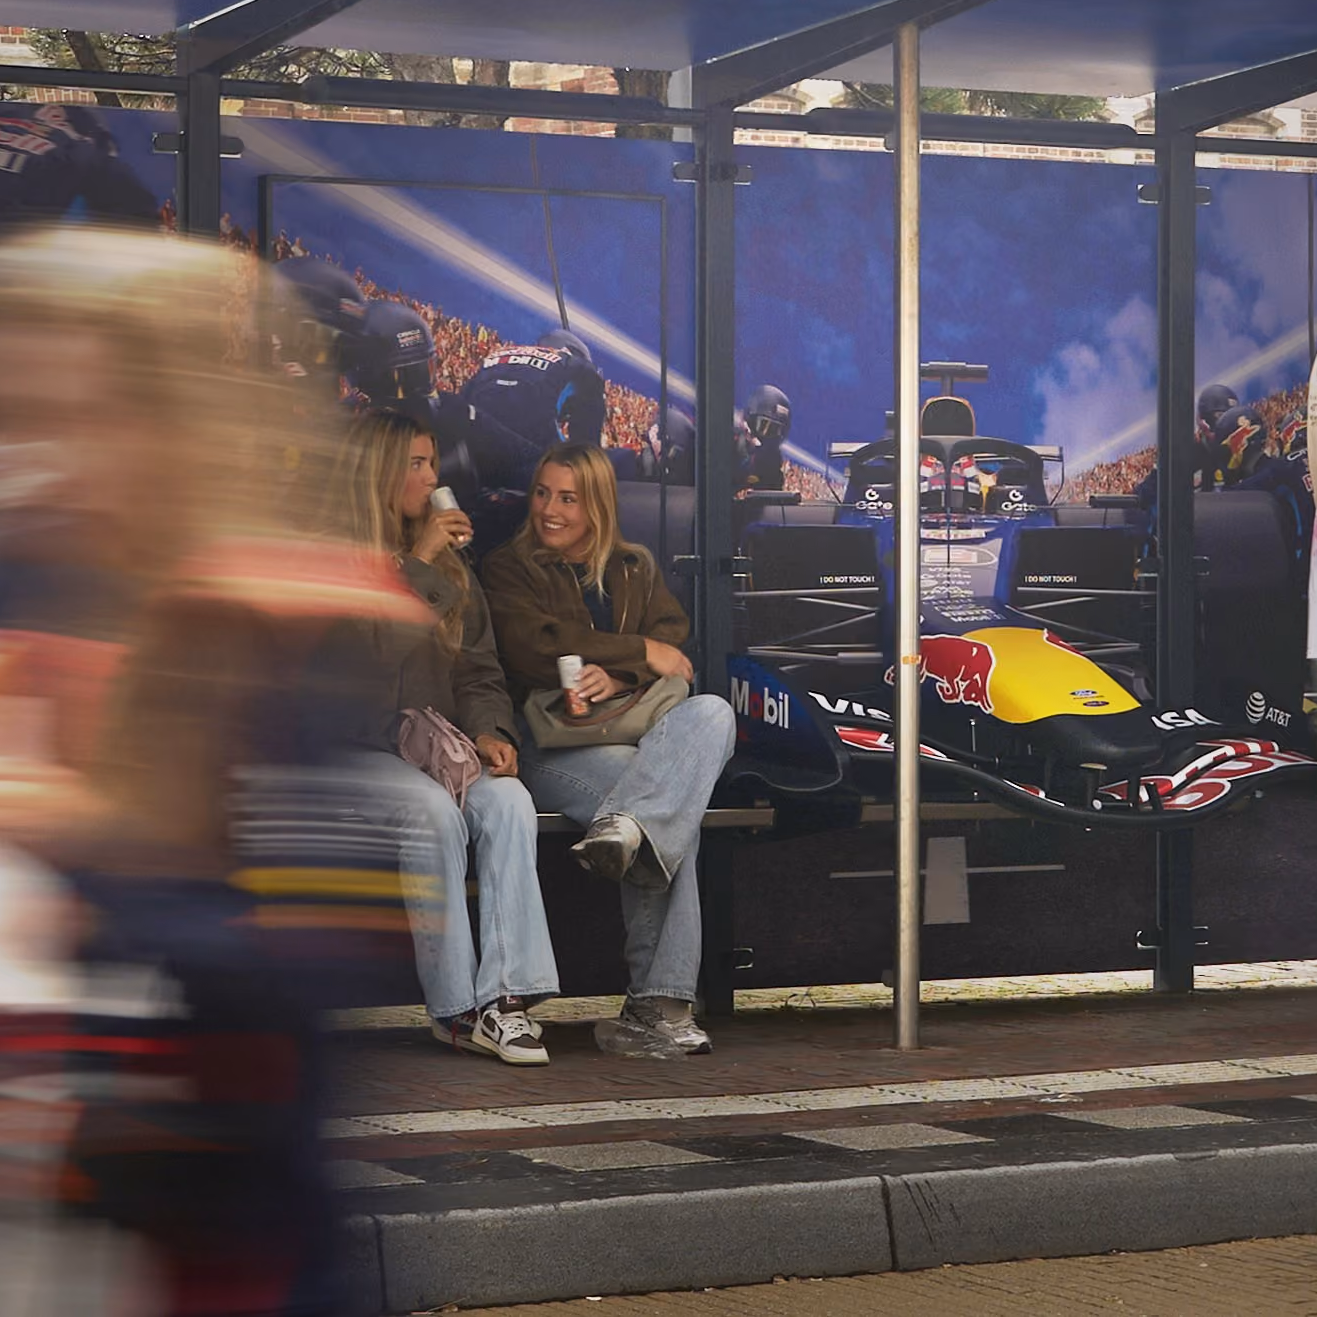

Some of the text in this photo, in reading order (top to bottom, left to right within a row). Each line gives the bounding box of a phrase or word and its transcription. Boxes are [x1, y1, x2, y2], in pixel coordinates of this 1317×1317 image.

[731, 676, 789, 729] Mobil
[808, 691, 895, 722] VIS
[1151, 708, 1223, 731] ISA
[1265, 706, 1292, 728] AT&T
